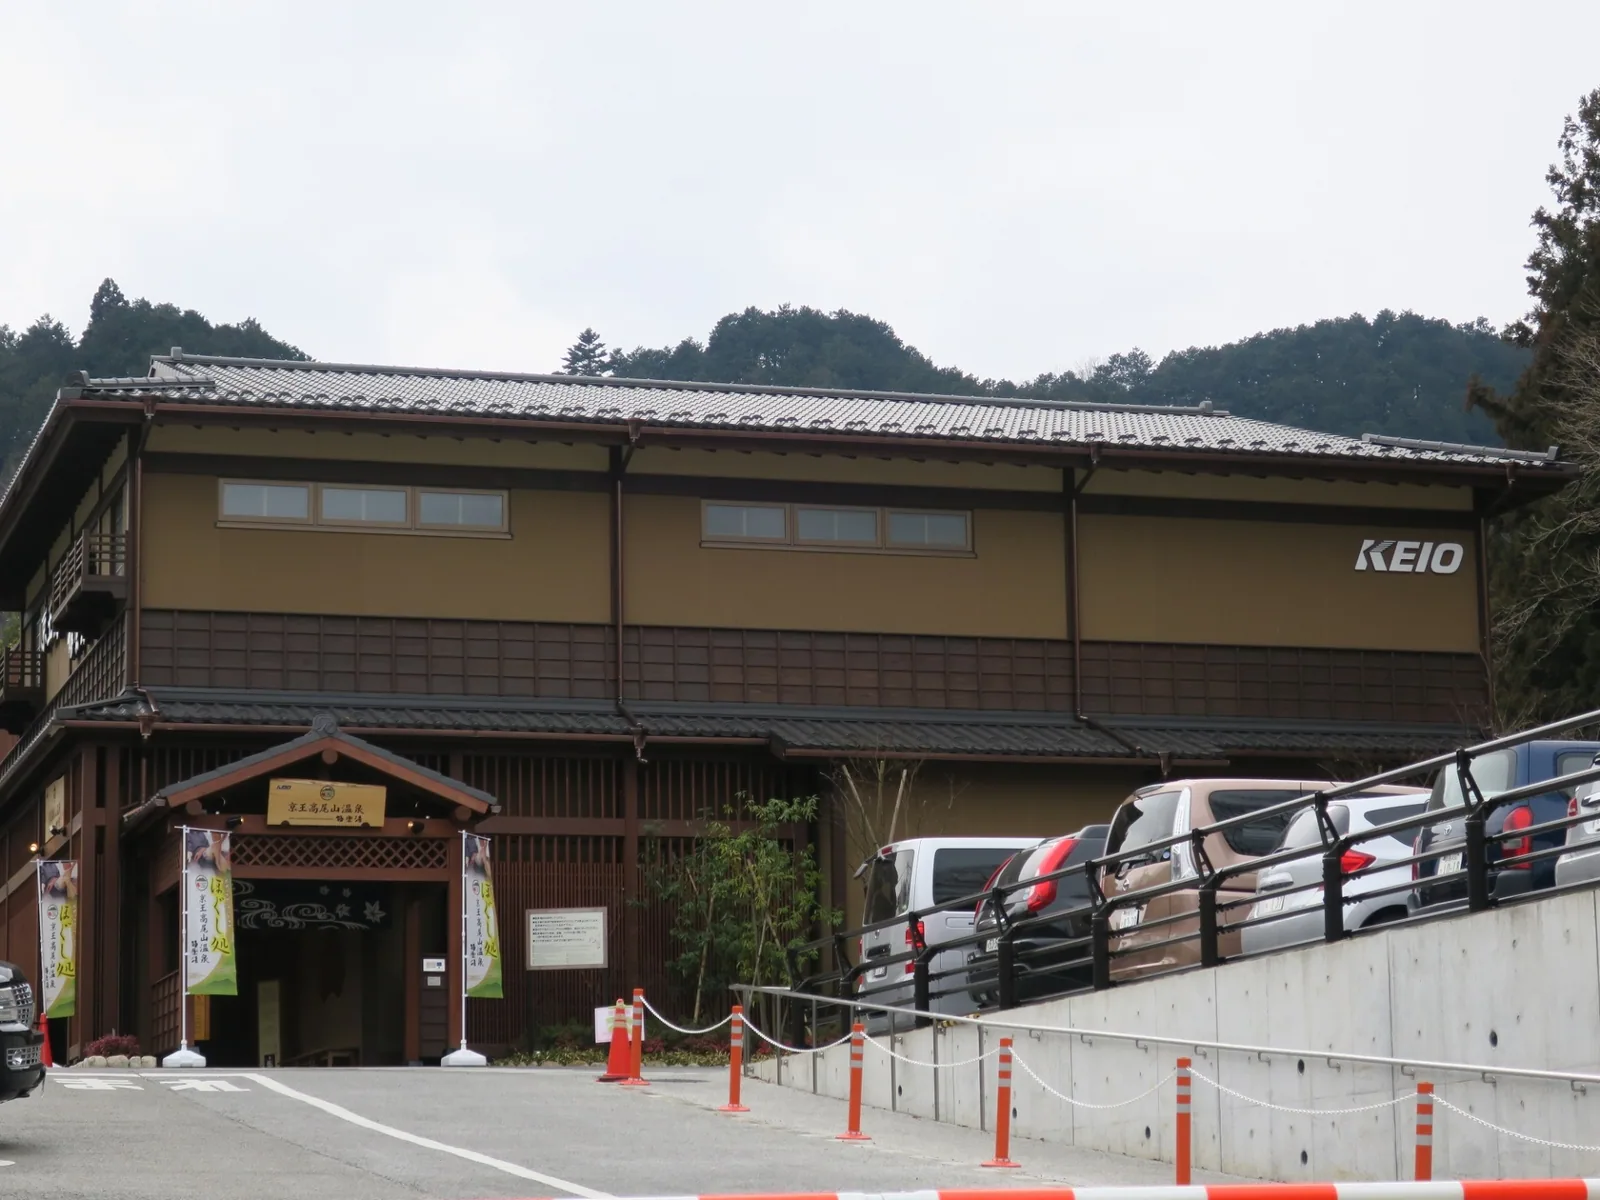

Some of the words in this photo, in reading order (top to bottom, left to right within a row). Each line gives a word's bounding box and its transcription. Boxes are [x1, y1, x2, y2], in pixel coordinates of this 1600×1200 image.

[1354, 539, 1464, 574] KEIO
[287, 802, 365, 815] 京王高尾山温泉
[56, 904, 75, 978] ほぐし処
[199, 894, 210, 964] 京王高尾山温泉
[210, 877, 230, 955] ほぐし処
[481, 883, 498, 959] ほぐし処
